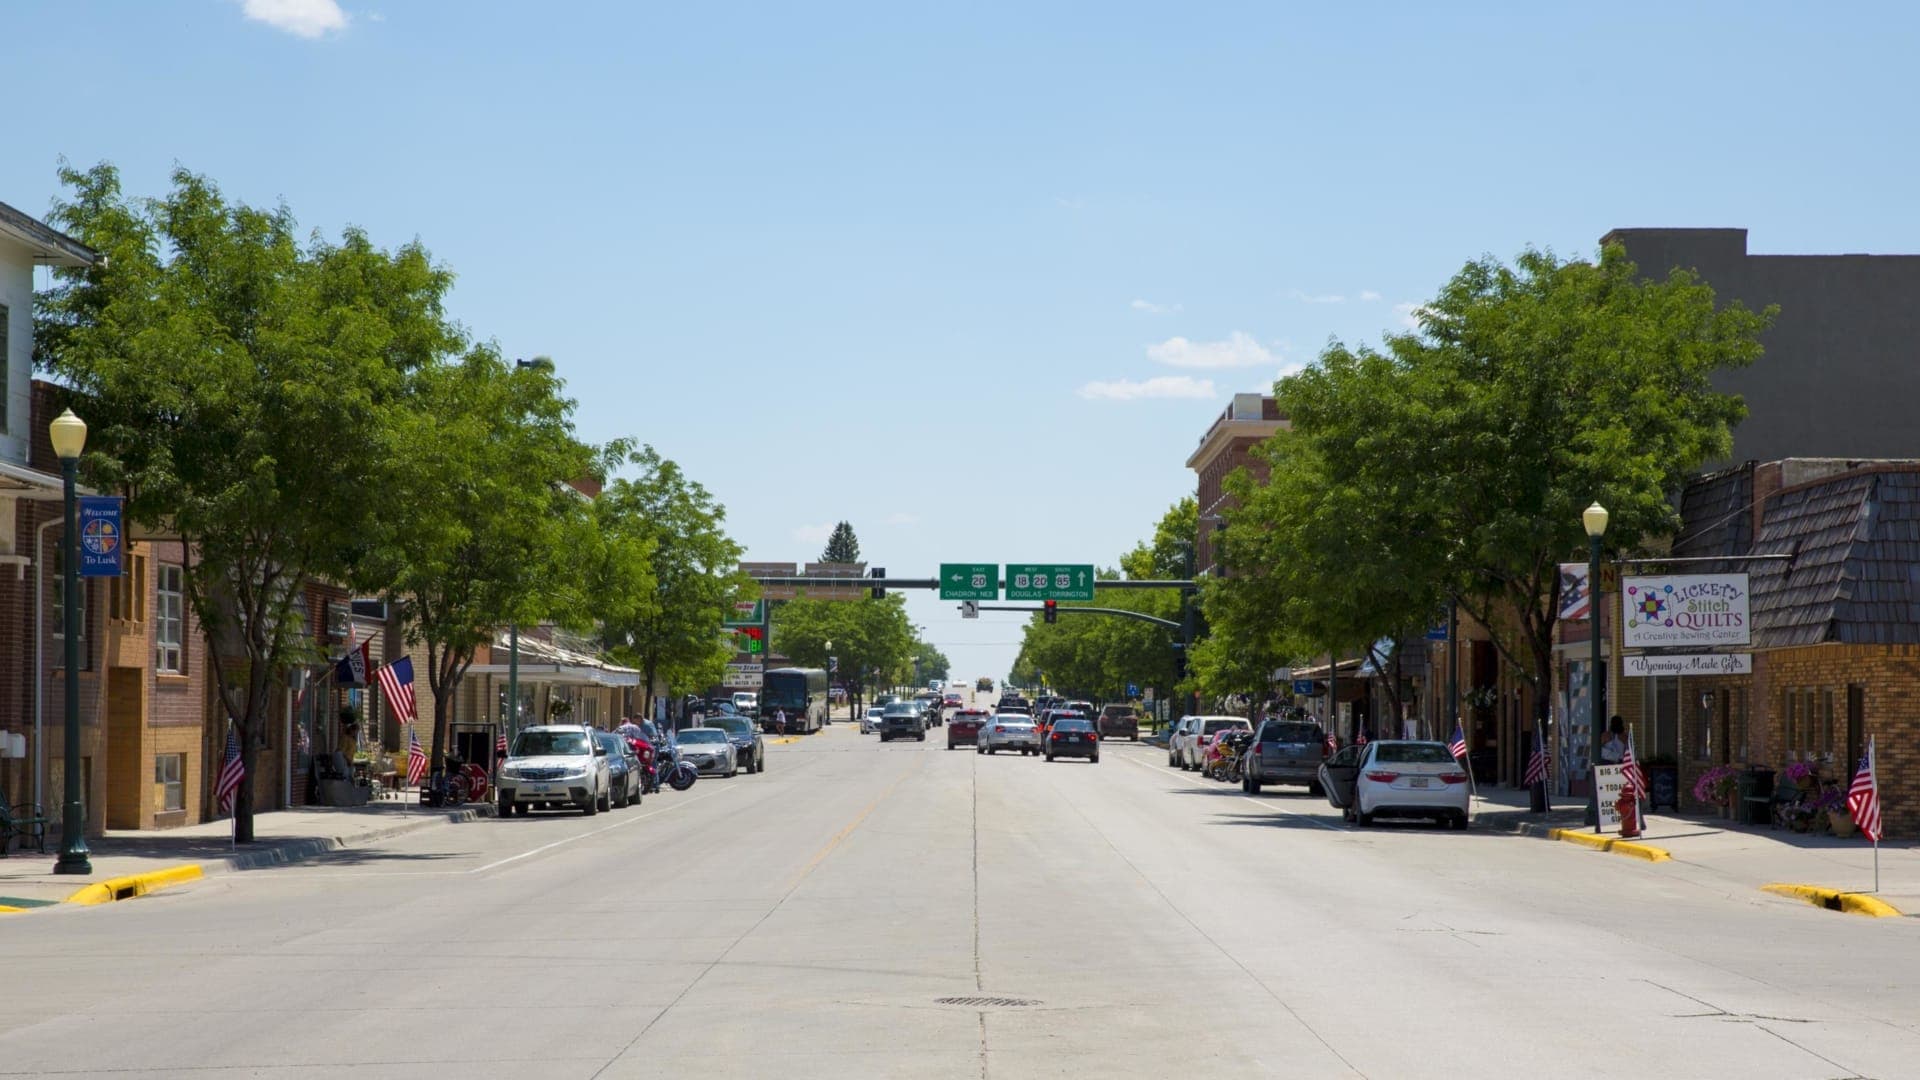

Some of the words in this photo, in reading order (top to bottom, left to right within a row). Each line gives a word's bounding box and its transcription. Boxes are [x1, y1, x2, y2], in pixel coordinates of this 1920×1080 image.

[973, 576, 985, 585] 20
[1017, 576, 1027, 585] 18
[1034, 576, 1047, 585] 20
[1056, 576, 1069, 585] 85
[1672, 583, 1744, 603] LICKETY
[1687, 599, 1730, 613] Stitch
[1676, 612, 1743, 630] QUILTS
[1634, 632, 1641, 641] A
[1642, 631, 1679, 641] Creative
[1681, 631, 1710, 641] Sewing
[1712, 630, 1740, 639] Center
[1631, 659, 1682, 673] Wyoming
[1685, 657, 1718, 670] Made
[1720, 656, 1743, 673] Gifts
[1600, 768, 1611, 776] BIG
[1605, 784, 1624, 792] TODA
